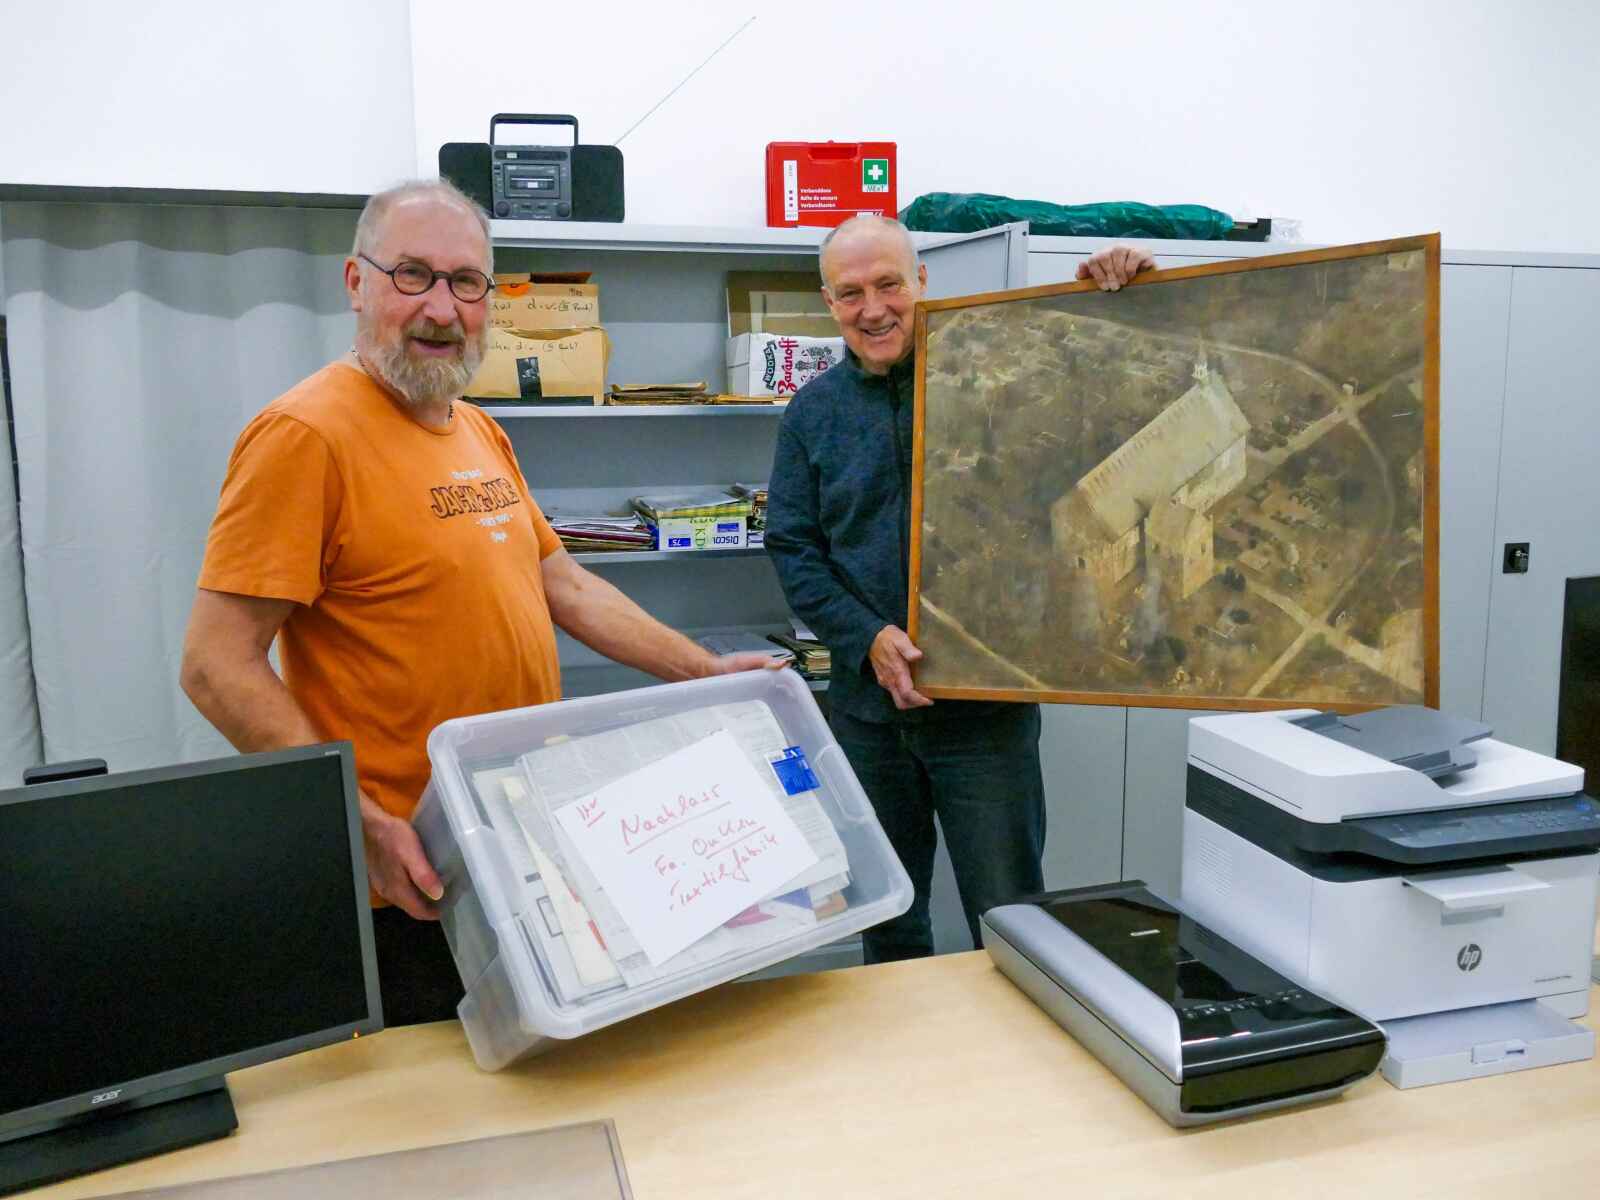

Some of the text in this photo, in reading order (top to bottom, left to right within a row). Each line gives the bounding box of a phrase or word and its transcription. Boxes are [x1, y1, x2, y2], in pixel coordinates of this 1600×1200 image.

[764, 346, 775, 382] WODKA
[778, 337, 799, 394] Zaranoff
[1457, 943, 1482, 971] hp
[91, 1089, 122, 1104] acer
